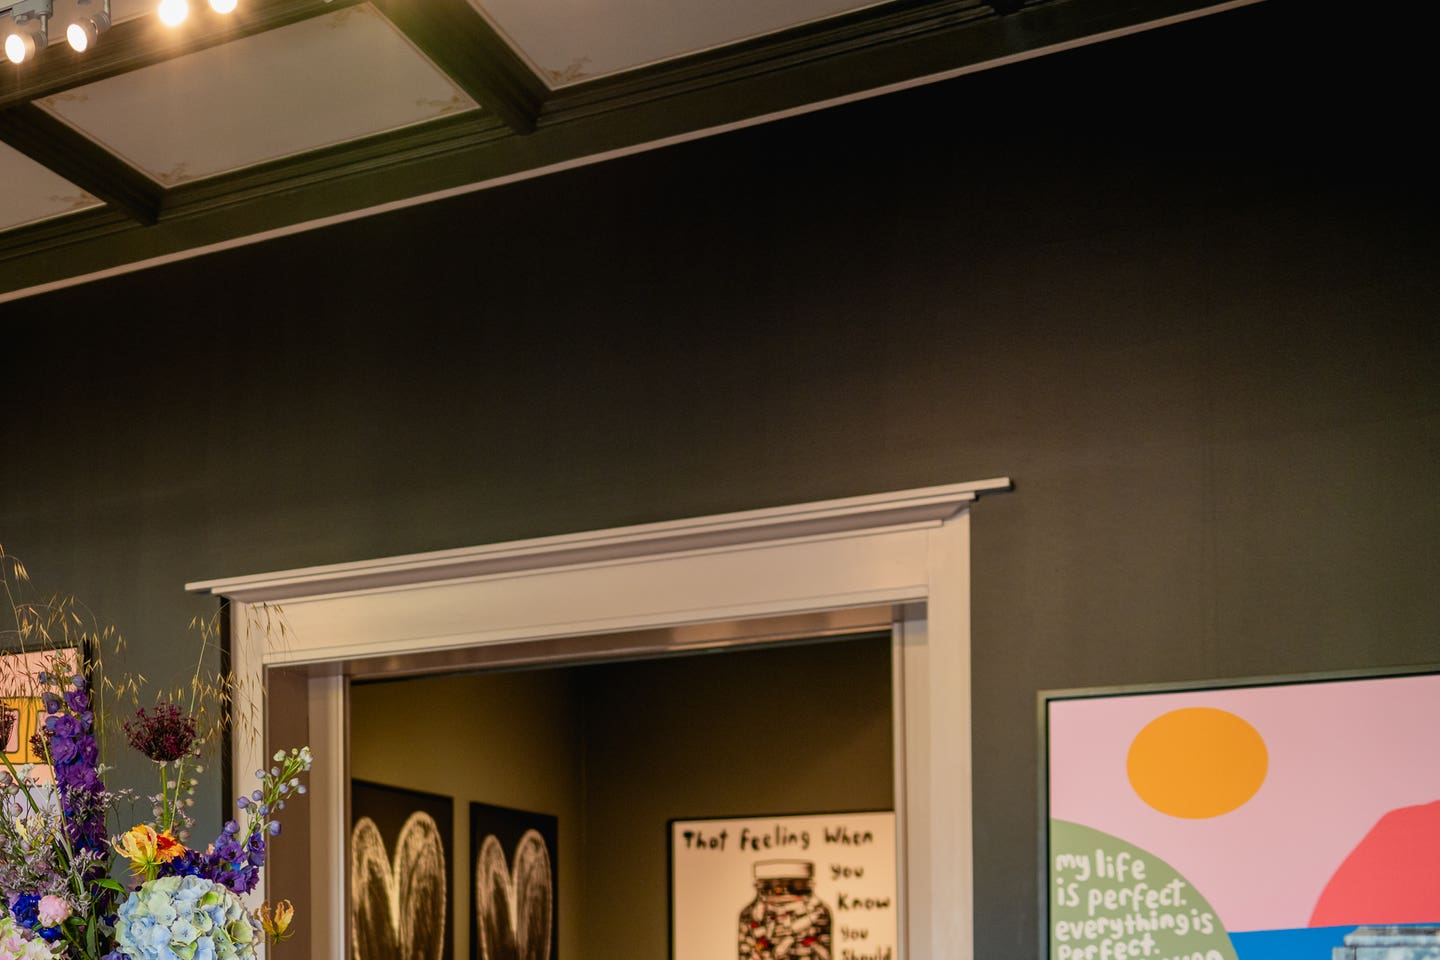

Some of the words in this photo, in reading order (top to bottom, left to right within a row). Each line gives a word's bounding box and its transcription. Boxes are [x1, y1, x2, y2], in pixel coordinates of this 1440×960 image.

[683, 830, 728, 851] That
[824, 826, 873, 846] When
[831, 864, 864, 881] you
[1056, 853, 1091, 881] my
[1095, 849, 1146, 882] life
[1056, 877, 1080, 907] is
[1088, 878, 1187, 916] perfect.
[841, 927, 869, 941] you
[1055, 910, 1189, 941] everything
[1190, 908, 1214, 935] is
